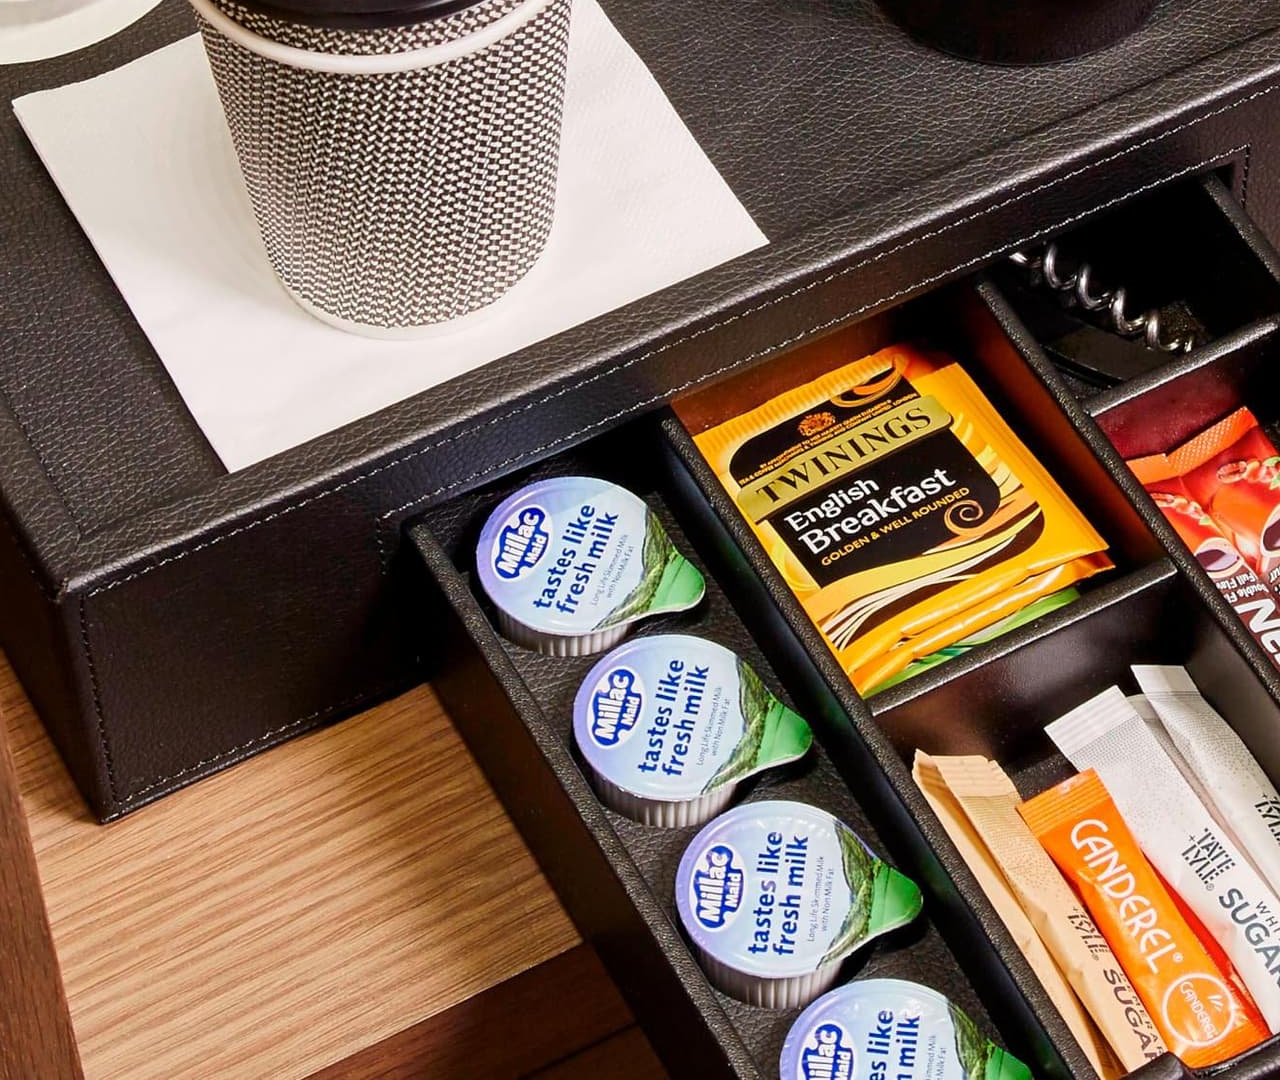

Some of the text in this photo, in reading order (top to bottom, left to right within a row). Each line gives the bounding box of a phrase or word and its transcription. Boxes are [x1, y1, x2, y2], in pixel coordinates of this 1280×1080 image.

[756, 407, 931, 503] TWININGS
[784, 479, 880, 532] English
[798, 469, 956, 555] Breakfast
[821, 487, 970, 566] GOLDEN & WELL ROUNDED
[497, 512, 539, 574] Millac
[524, 534, 547, 564] Maid
[533, 505, 595, 608] tastes like
[556, 512, 619, 614] fresh milk
[1236, 572, 1257, 586] Full
[595, 675, 629, 740] Millac
[621, 696, 641, 726] Maid
[638, 660, 684, 772] tastes like
[662, 666, 709, 775] fresh milk
[1182, 845, 1220, 885] LYLE
[1195, 828, 1236, 874] TATE
[699, 851, 728, 922] Millac
[724, 873, 742, 907] Maid
[748, 832, 782, 954] tastes like
[773, 836, 808, 955] fresh milk
[1071, 819, 1177, 974] CANDEREL
[866, 1010, 894, 1054] like
[895, 1012, 920, 1067] milk
[1179, 981, 1218, 1039] CANDEREL
[807, 1030, 838, 1080] illac
